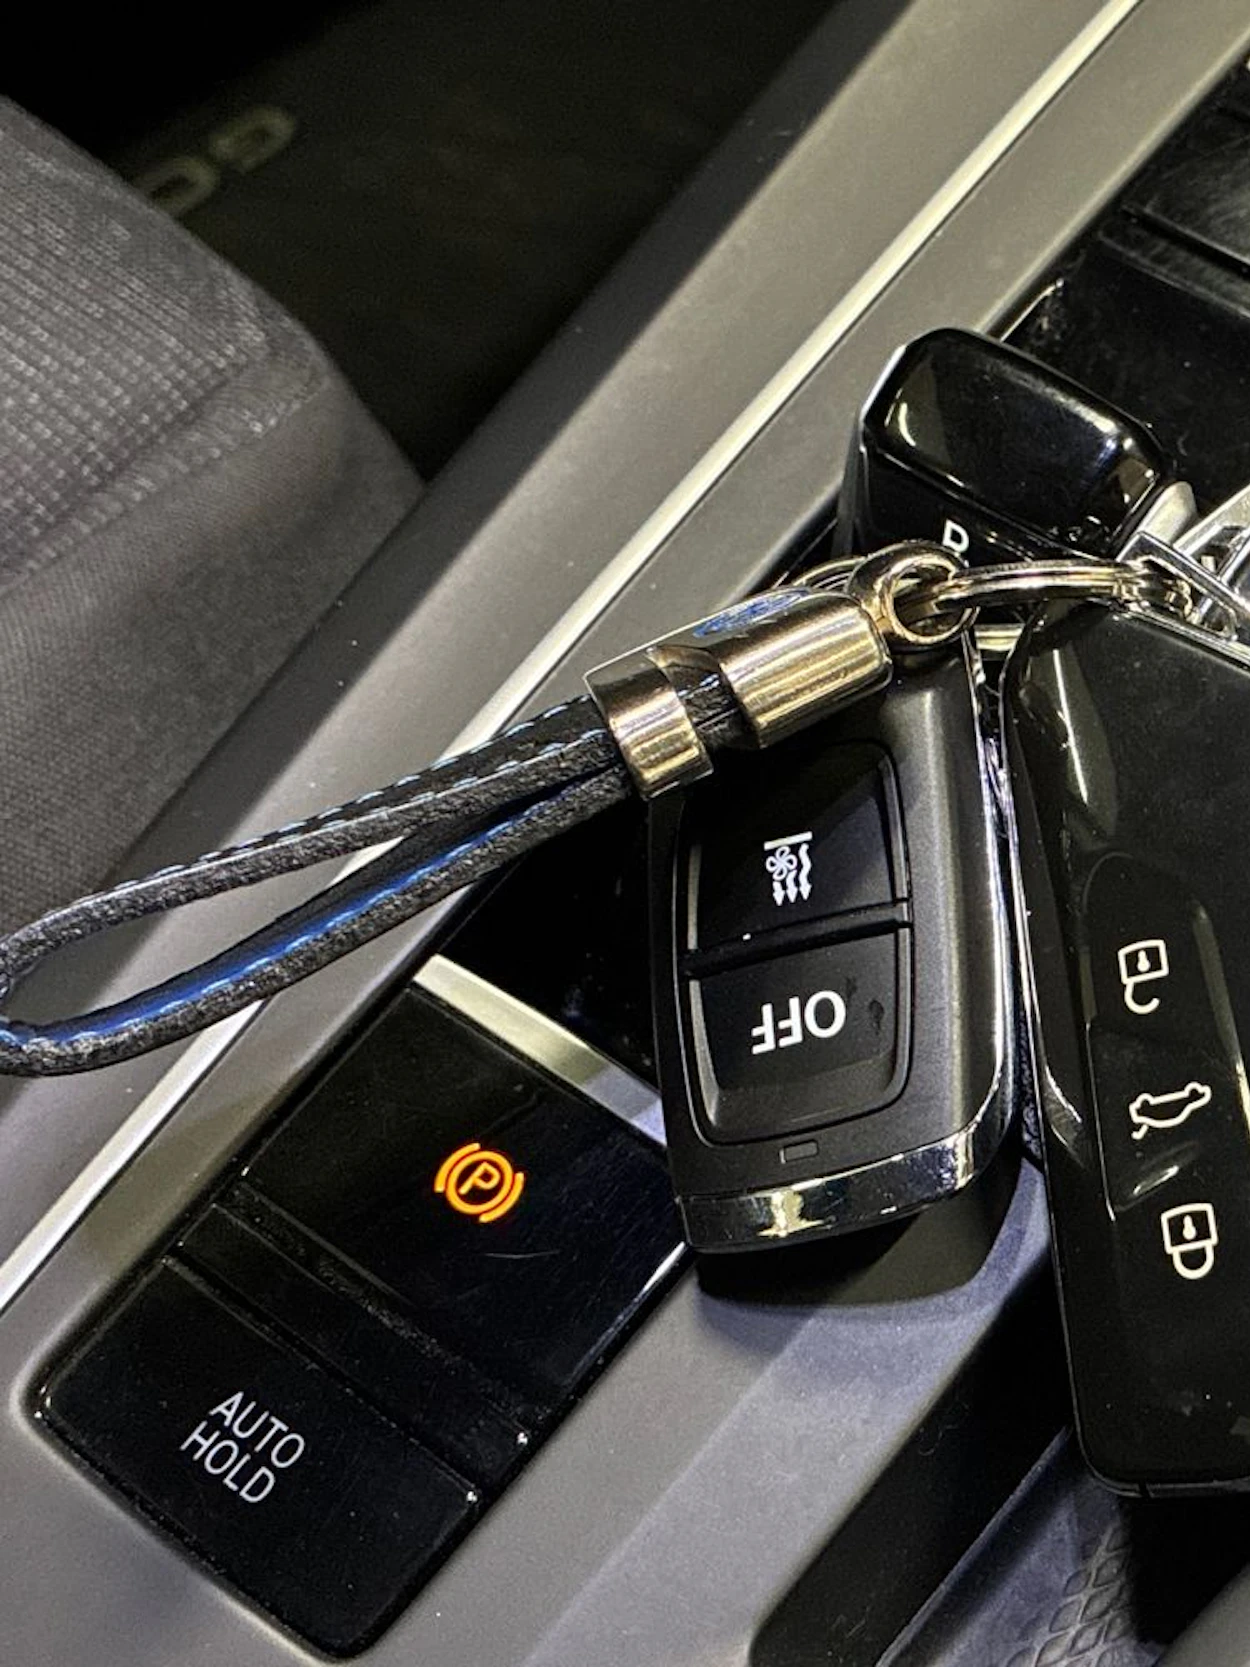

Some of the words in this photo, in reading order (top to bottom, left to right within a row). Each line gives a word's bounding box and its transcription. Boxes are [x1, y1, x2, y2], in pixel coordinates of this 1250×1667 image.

[751, 990, 847, 1055] OFF
[180, 1420, 276, 1503] HOLD
[208, 1391, 306, 1469] AUTO
